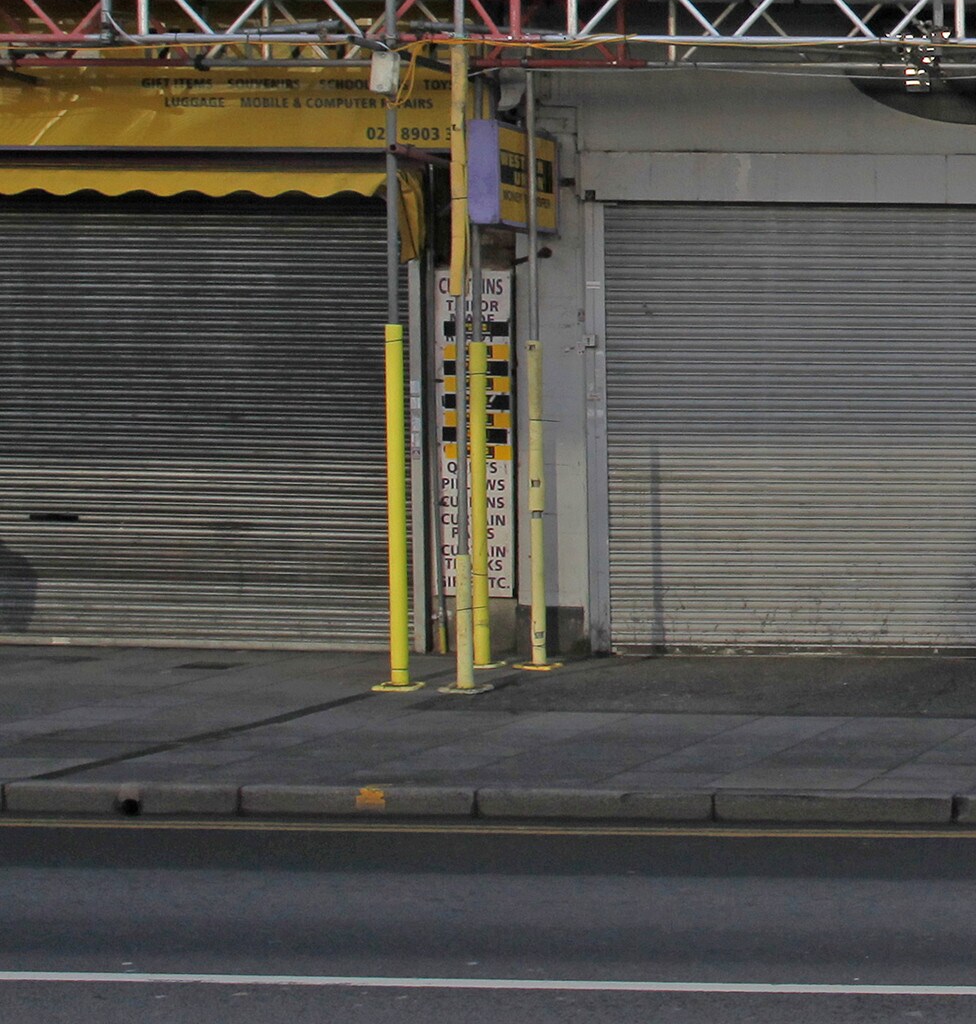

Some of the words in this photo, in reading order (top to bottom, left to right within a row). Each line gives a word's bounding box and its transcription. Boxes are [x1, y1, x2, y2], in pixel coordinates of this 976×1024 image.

[165, 97, 225, 108] LUGGAGE
[241, 97, 289, 108] MOBILE
[293, 98, 302, 108] &
[306, 98, 377, 109] COMPUTER
[401, 127, 440, 141] 8903
